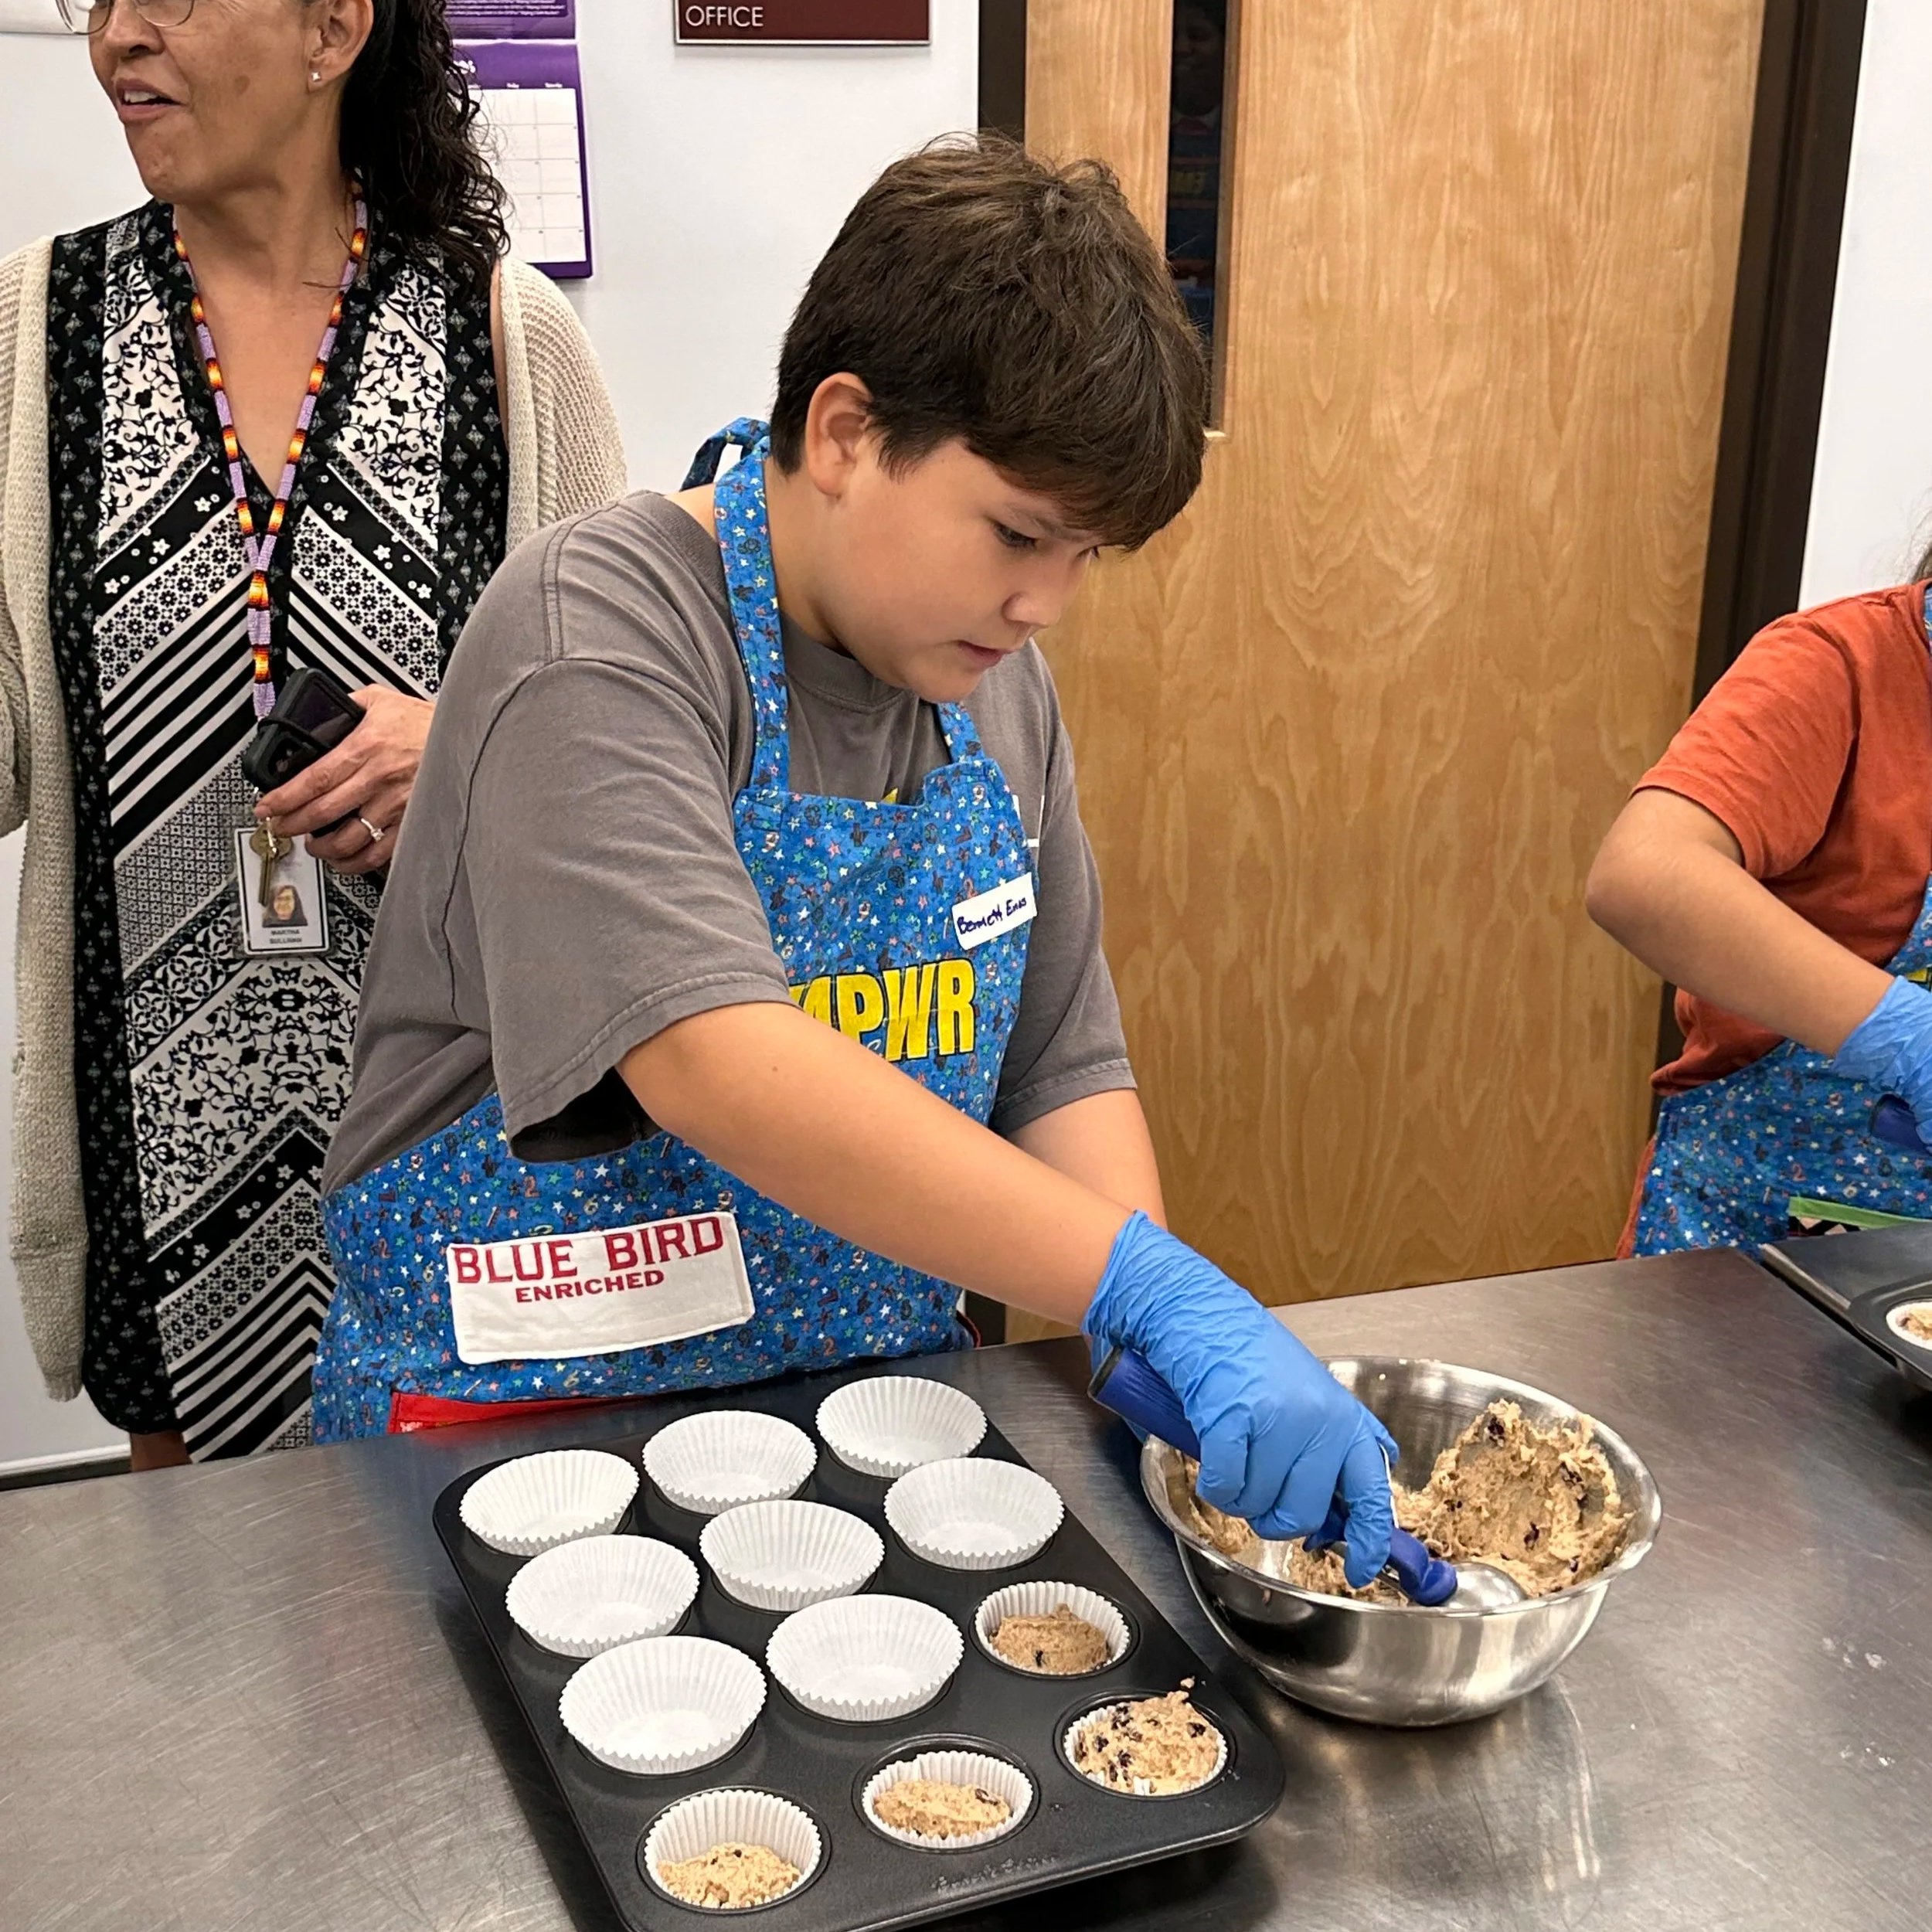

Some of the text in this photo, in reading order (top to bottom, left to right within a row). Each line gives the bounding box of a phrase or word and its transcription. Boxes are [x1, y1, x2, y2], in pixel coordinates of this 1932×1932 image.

[685, 5, 764, 27] OFFICE
[451, 1216, 724, 1284] BLUE BIRD
[515, 1270, 665, 1303] ENRICHED
